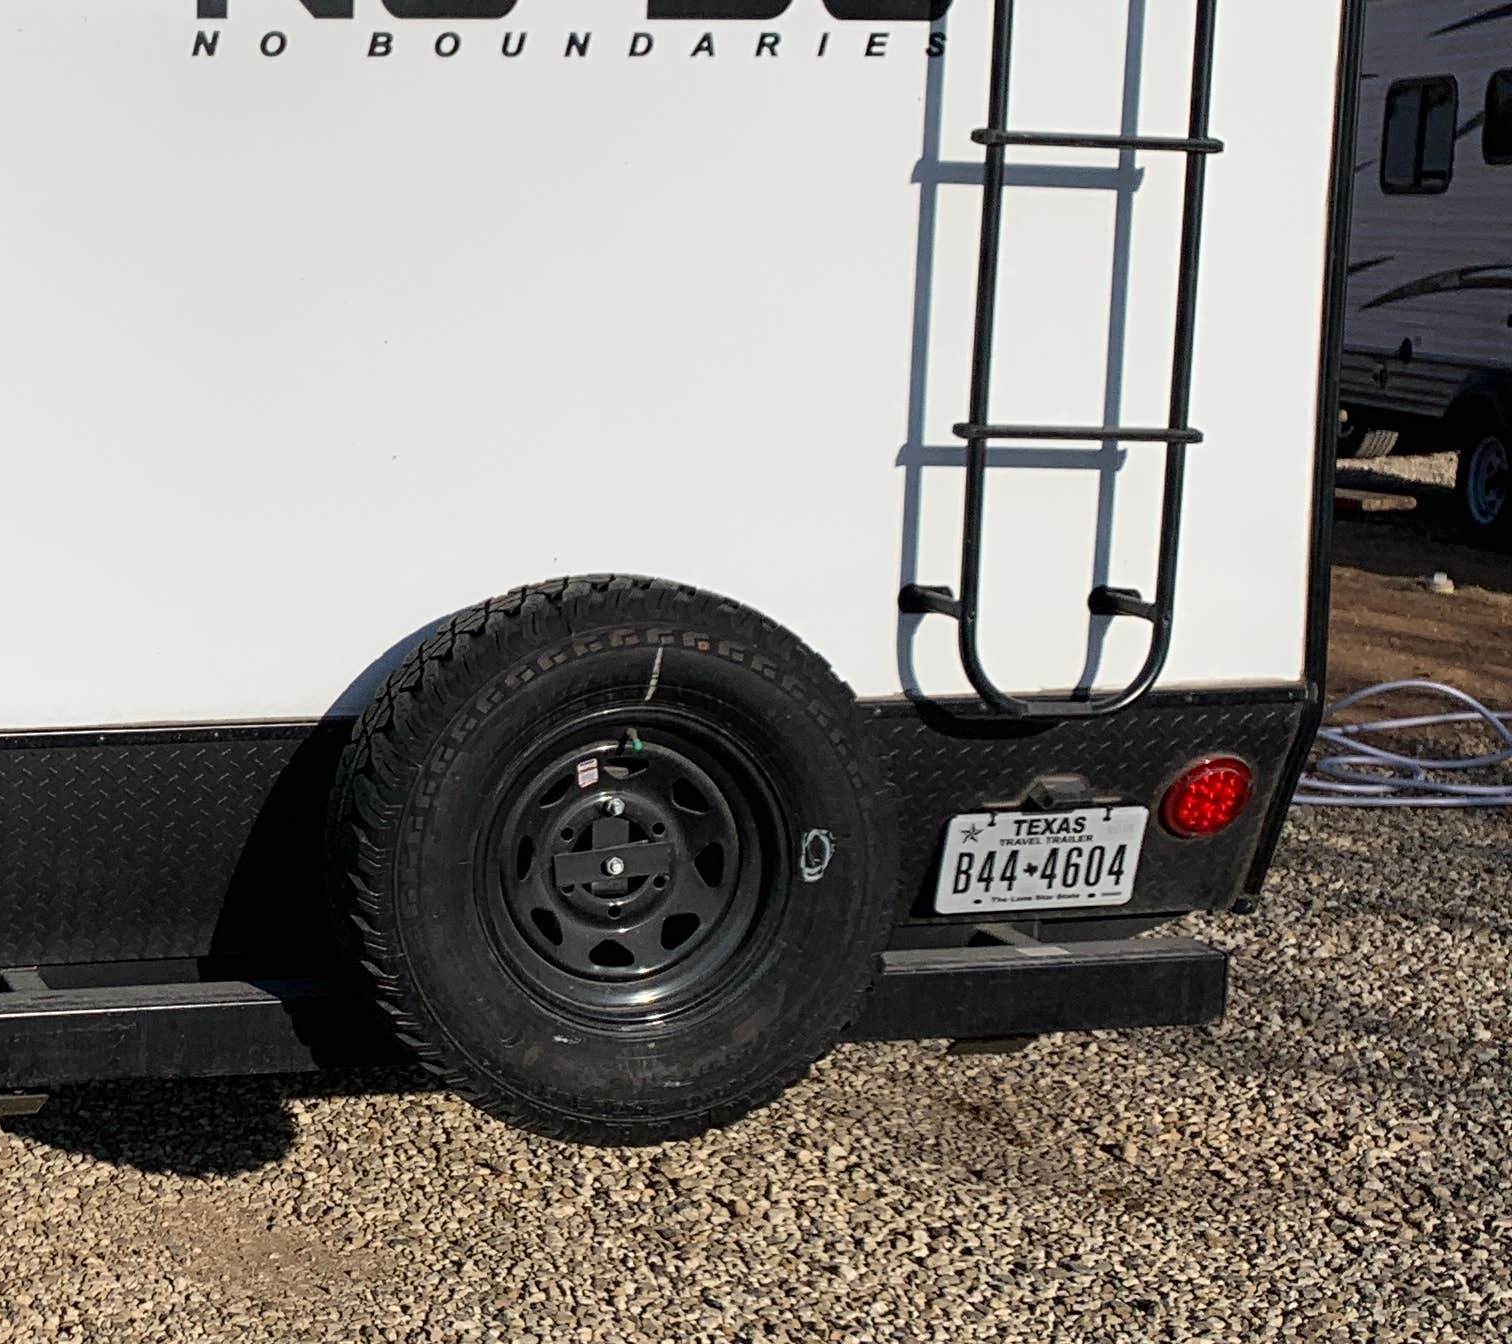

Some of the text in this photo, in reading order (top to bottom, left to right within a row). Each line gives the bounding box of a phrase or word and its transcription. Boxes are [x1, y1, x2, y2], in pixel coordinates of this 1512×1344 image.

[192, 31, 948, 58] NO BOUNDARIES
[1013, 816, 1087, 837] TEXAS
[999, 834, 1094, 847] TRAVEL TRAILER
